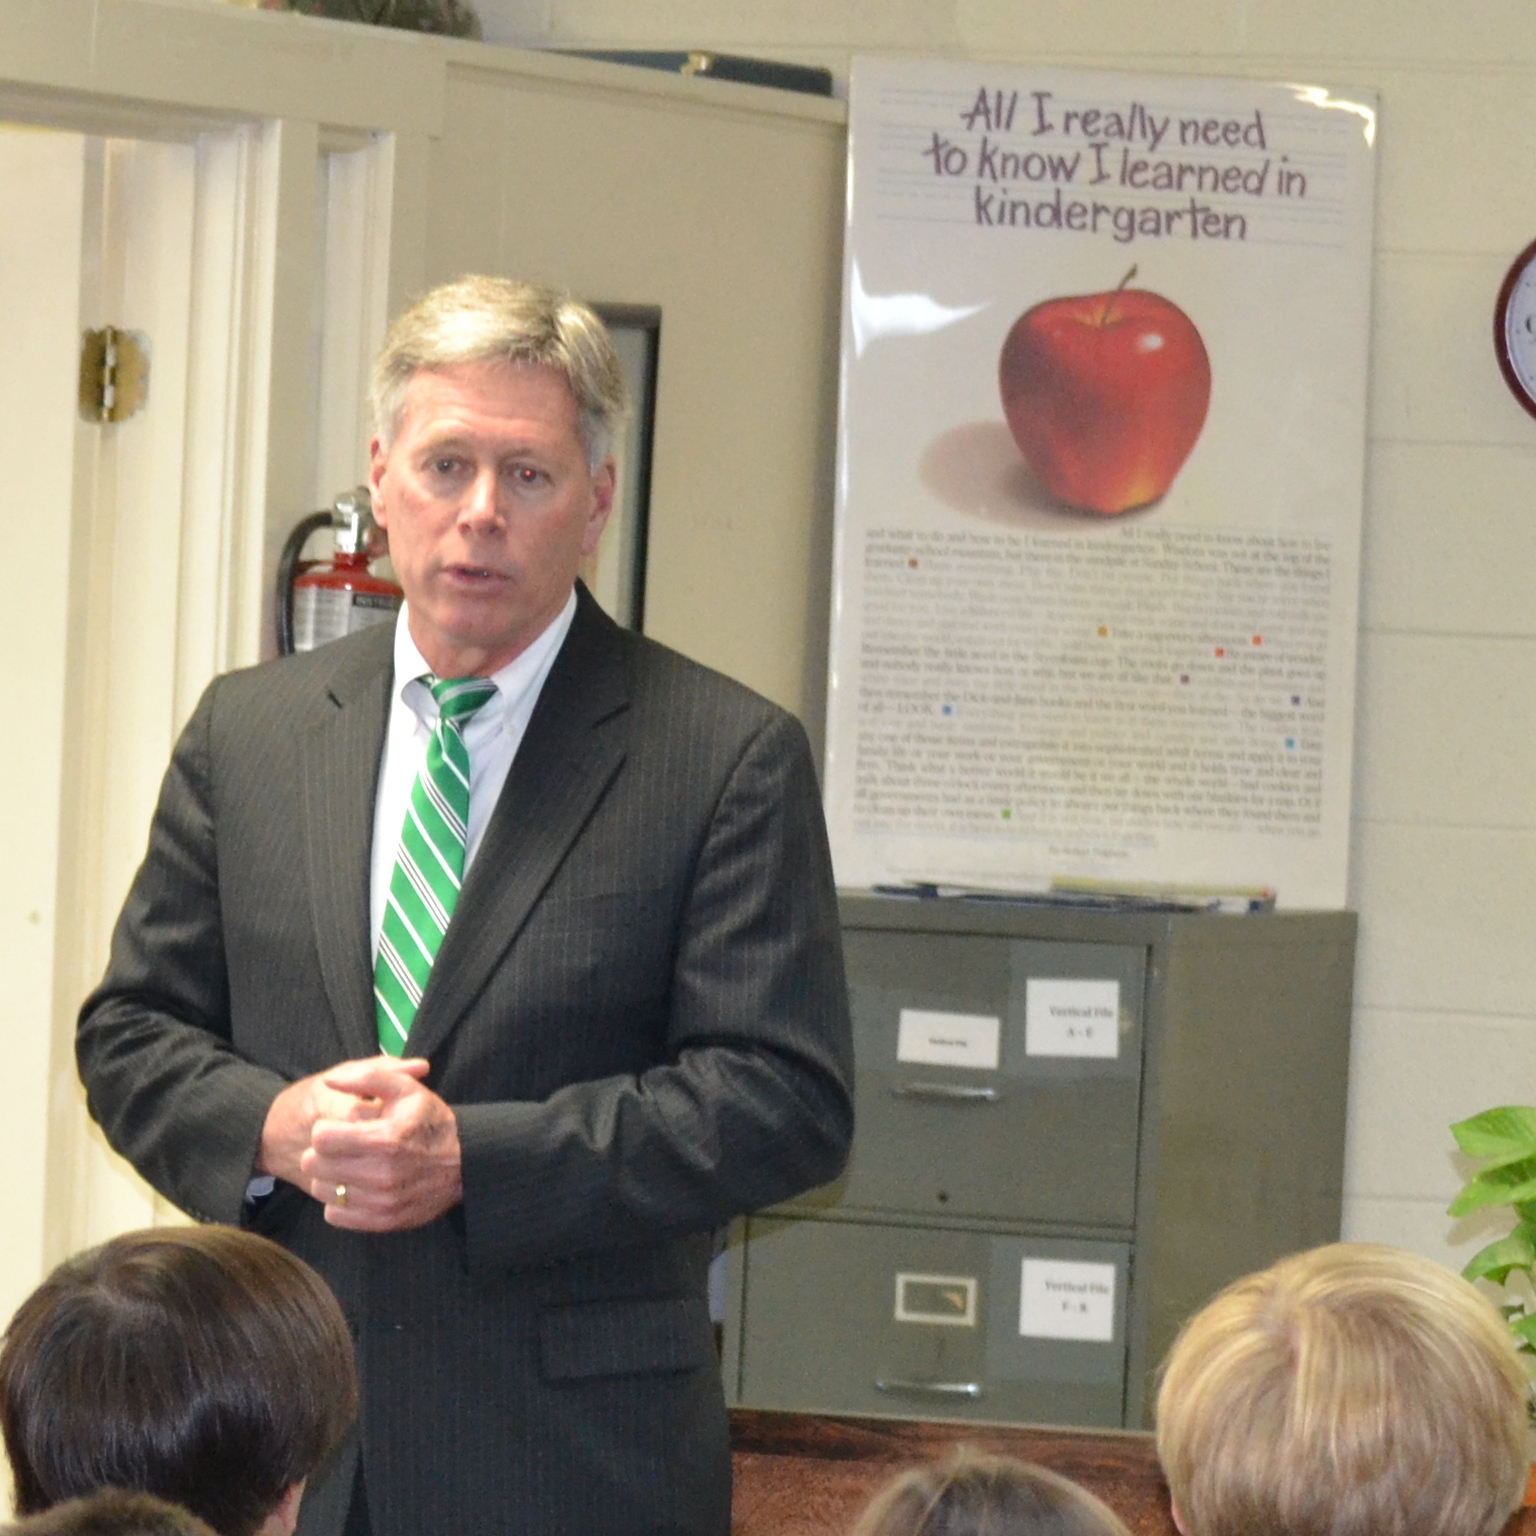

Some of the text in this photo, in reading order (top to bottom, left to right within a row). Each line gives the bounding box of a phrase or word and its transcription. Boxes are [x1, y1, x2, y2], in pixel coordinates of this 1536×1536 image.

[961, 85, 1266, 151] All I really need
[922, 131, 1307, 198] to know I learned in
[974, 186, 1249, 243] kindergarten
[1049, 1005, 1114, 1019] Vertical File
